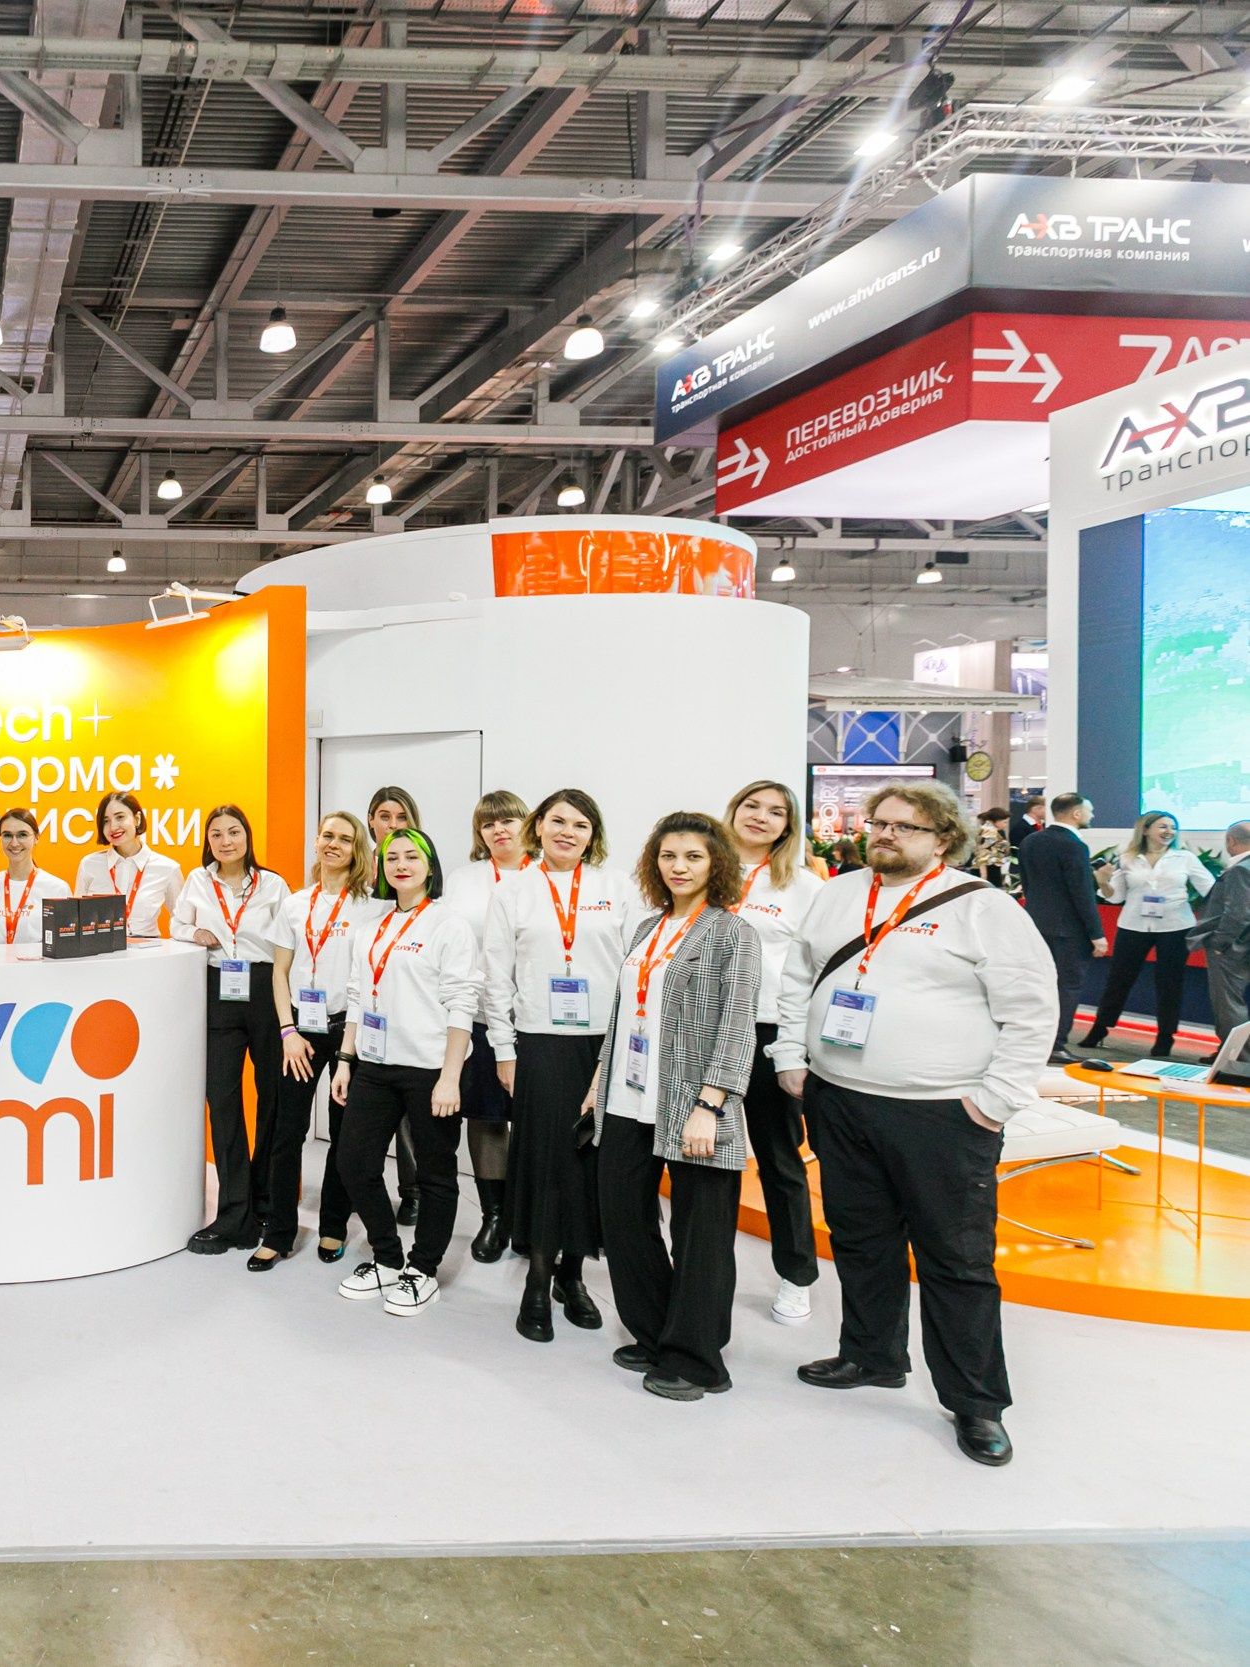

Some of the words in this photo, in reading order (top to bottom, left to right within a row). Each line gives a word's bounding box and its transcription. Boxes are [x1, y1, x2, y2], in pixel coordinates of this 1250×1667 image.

[1006, 244, 1112, 260] транспортная
[1117, 248, 1190, 262] компания
[1087, 215, 1191, 245] ТРАНС
[808, 246, 941, 330] www.ahvtrans.ru
[712, 326, 775, 377] ТРАНС
[671, 378, 728, 414] транспортная
[786, 361, 954, 449] ПЕРЕВОЗЧИК,
[1102, 433, 1250, 492] транспо
